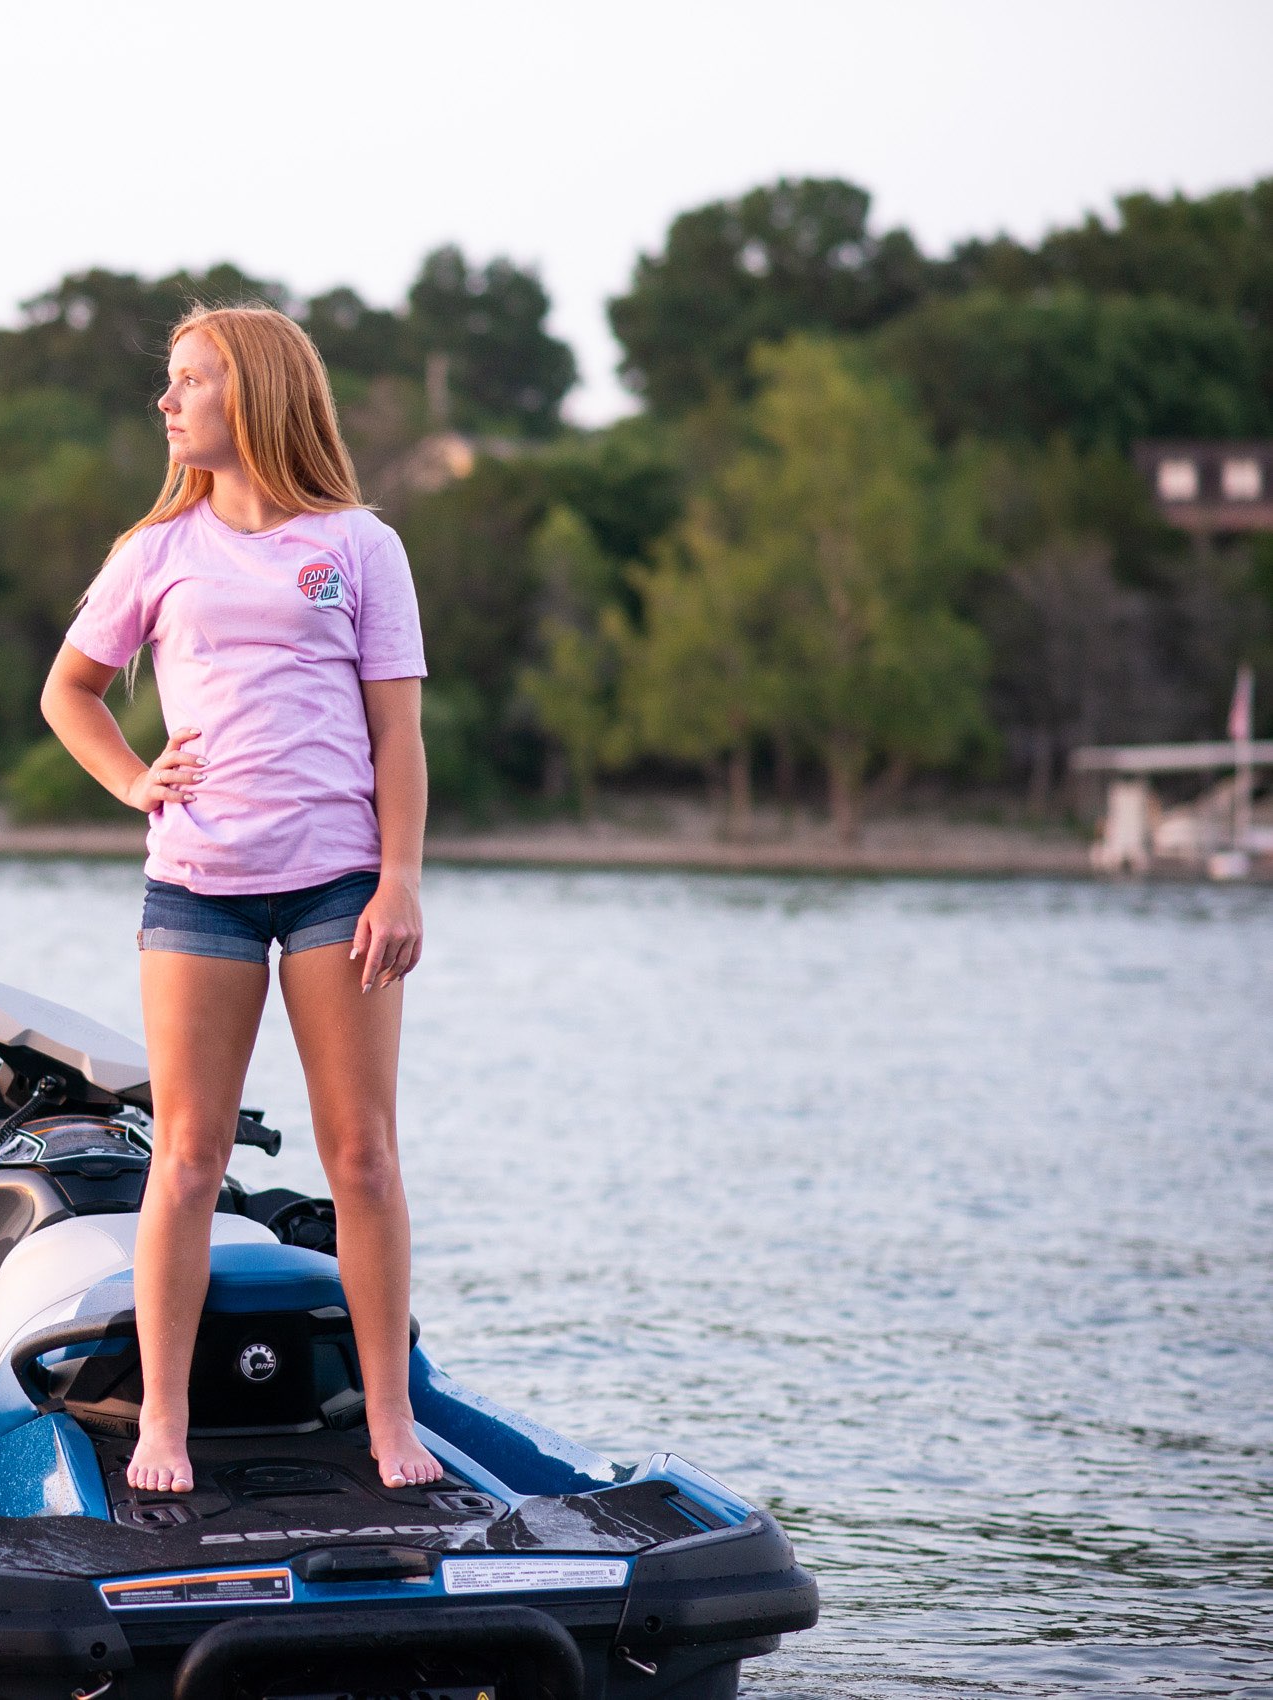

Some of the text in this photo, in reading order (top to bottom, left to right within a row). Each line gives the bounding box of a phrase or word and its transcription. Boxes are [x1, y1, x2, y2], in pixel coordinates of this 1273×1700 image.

[297, 567, 340, 587] SANTA
[307, 583, 339, 601] CRUZ
[86, 1416, 118, 1432] PUSH
